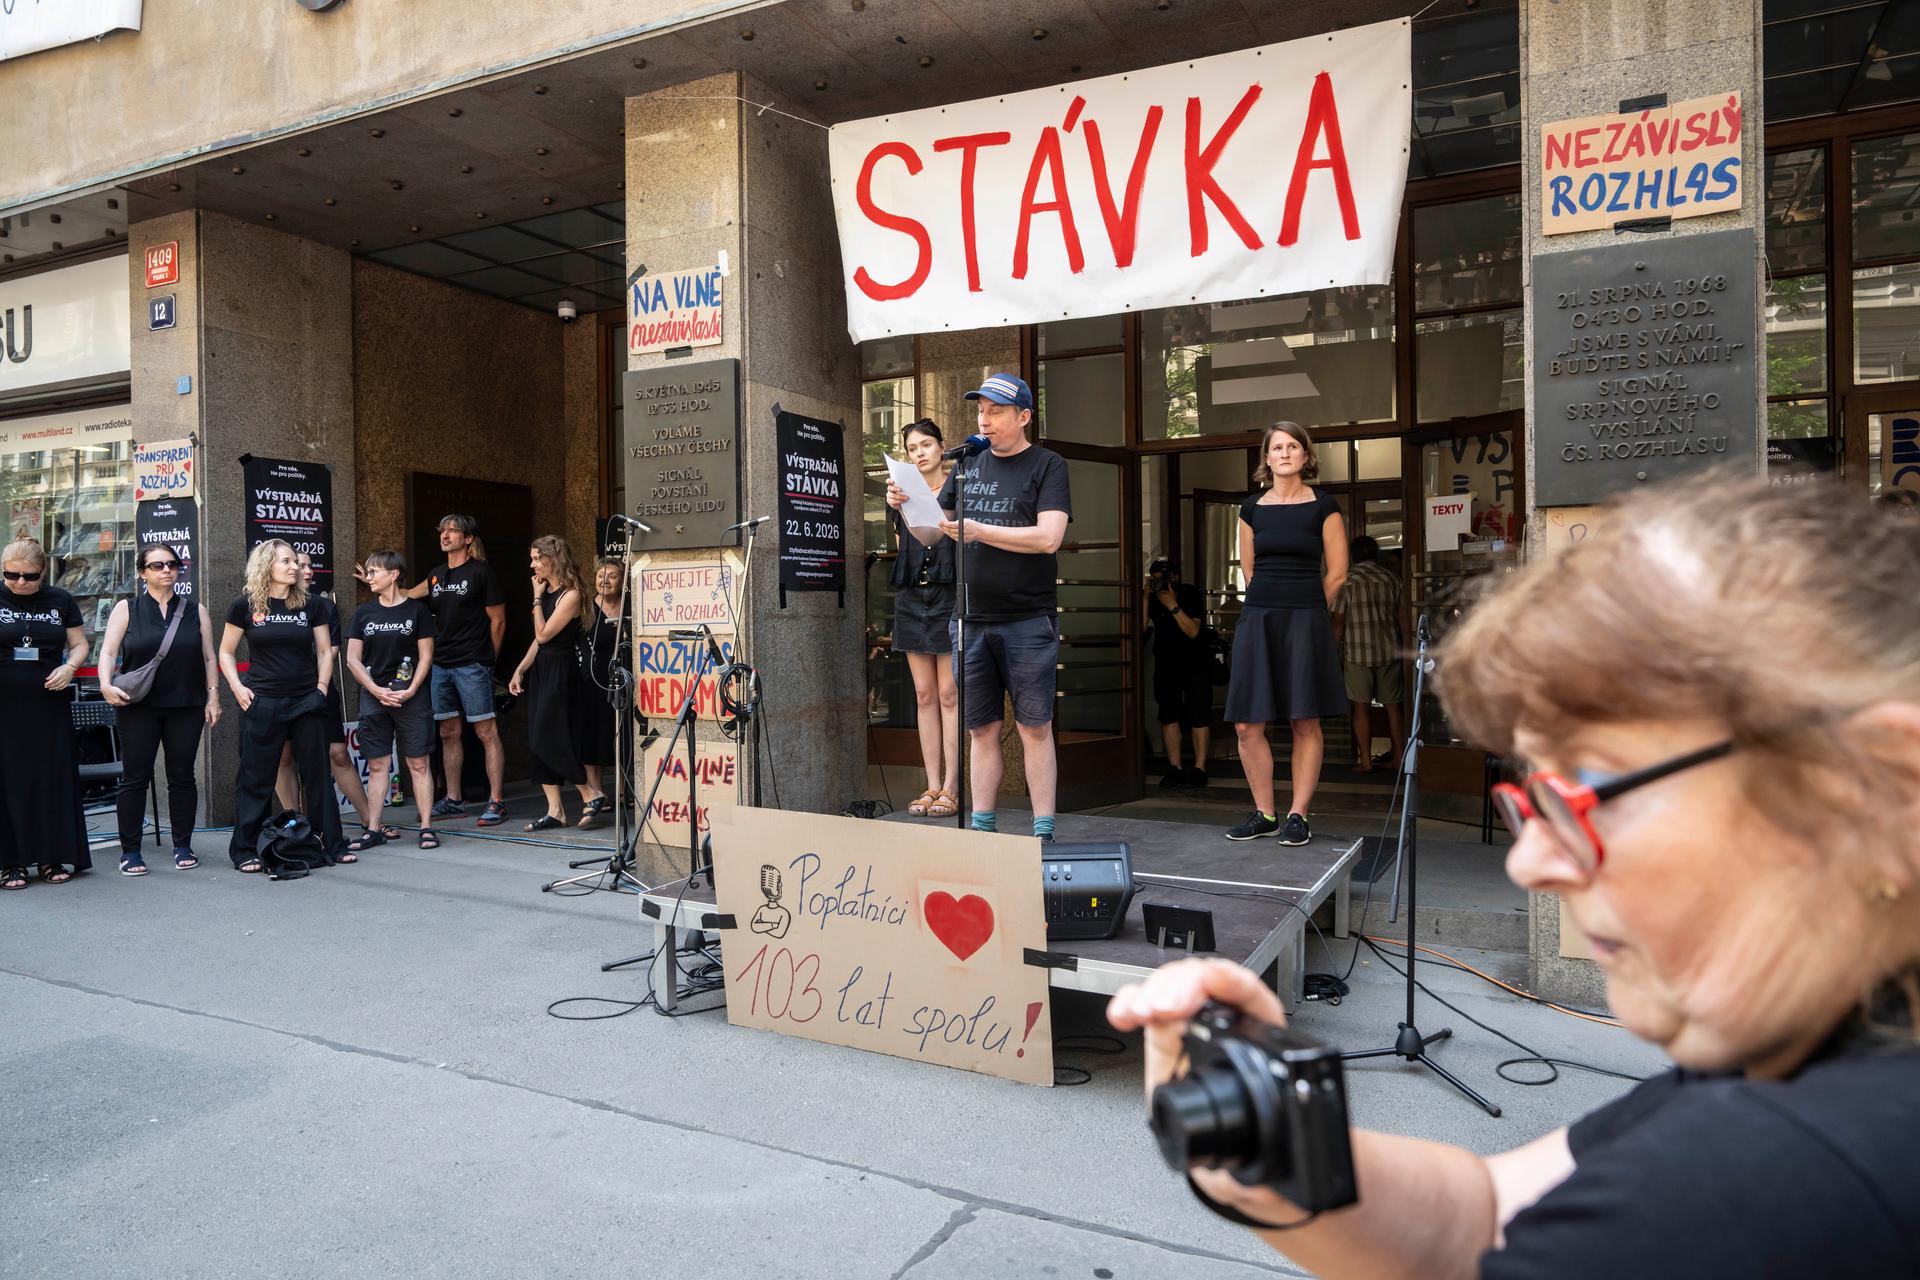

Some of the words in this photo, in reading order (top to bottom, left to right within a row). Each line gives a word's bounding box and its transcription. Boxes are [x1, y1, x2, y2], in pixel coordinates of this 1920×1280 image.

[1545, 95, 1741, 170] NEZÁVISLÝ
[854, 71, 1360, 301] STÁVKA
[1550, 157, 1741, 216] ROZHLAS
[148, 248, 172, 268] 1409
[634, 279, 668, 318] NA
[674, 266, 721, 308] VLNĚ
[1558, 291, 1584, 309] 21.
[1590, 281, 1666, 305] SRPNA
[1675, 275, 1727, 295] 1968
[155, 303, 166, 321] 12
[1652, 299, 1715, 320] HOD.
[1637, 329, 1649, 346] S
[1637, 351, 1649, 368] S
[645, 384, 689, 399] KVĚTNA
[693, 380, 720, 393] 1945
[1599, 370, 1688, 396] SIGNÁL
[680, 399, 711, 412] HOD.
[1566, 392, 1720, 419] SRPNOVÉHO
[22, 427, 73, 440] www.multiland.cz
[653, 424, 701, 440] VOLÁME
[1590, 413, 1696, 439] VYSÍLÁNÍ
[135, 446, 193, 463] TRANSPARENT
[630, 443, 685, 458] VŠECHNY
[687, 438, 730, 454] ČECHY
[1560, 443, 1592, 462] ČS.
[1599, 437, 1728, 460] ROZHLASU
[156, 463, 174, 475] PRO
[786, 452, 838, 475] VÝSTRAŽNÁ
[140, 471, 187, 489] ROZHLAS
[657, 466, 703, 482] SIGNÁL
[786, 470, 839, 498] STÁVKA
[255, 488, 322, 504] VÝSTRAŽNÁ
[651, 482, 708, 499] POVSTÁNÍ
[256, 502, 323, 522] STÁVKA
[635, 502, 691, 517] ČESKÉHO
[696, 499, 725, 513] LIDU
[1432, 504, 1464, 516] TEXTY
[142, 526, 191, 543] VÝSTRAŽNÁ
[786, 519, 801, 536] 22.
[804, 521, 813, 537] 6.
[815, 522, 840, 539] 2026
[642, 569, 713, 591] NESAHEJTE
[647, 607, 665, 623] NA
[676, 603, 726, 621] ROZHLAS
[375, 622, 404, 630] STÁVKA
[657, 754, 688, 782] NA
[789, 853, 909, 930] Poplatníci
[736, 944, 822, 1022] 103
